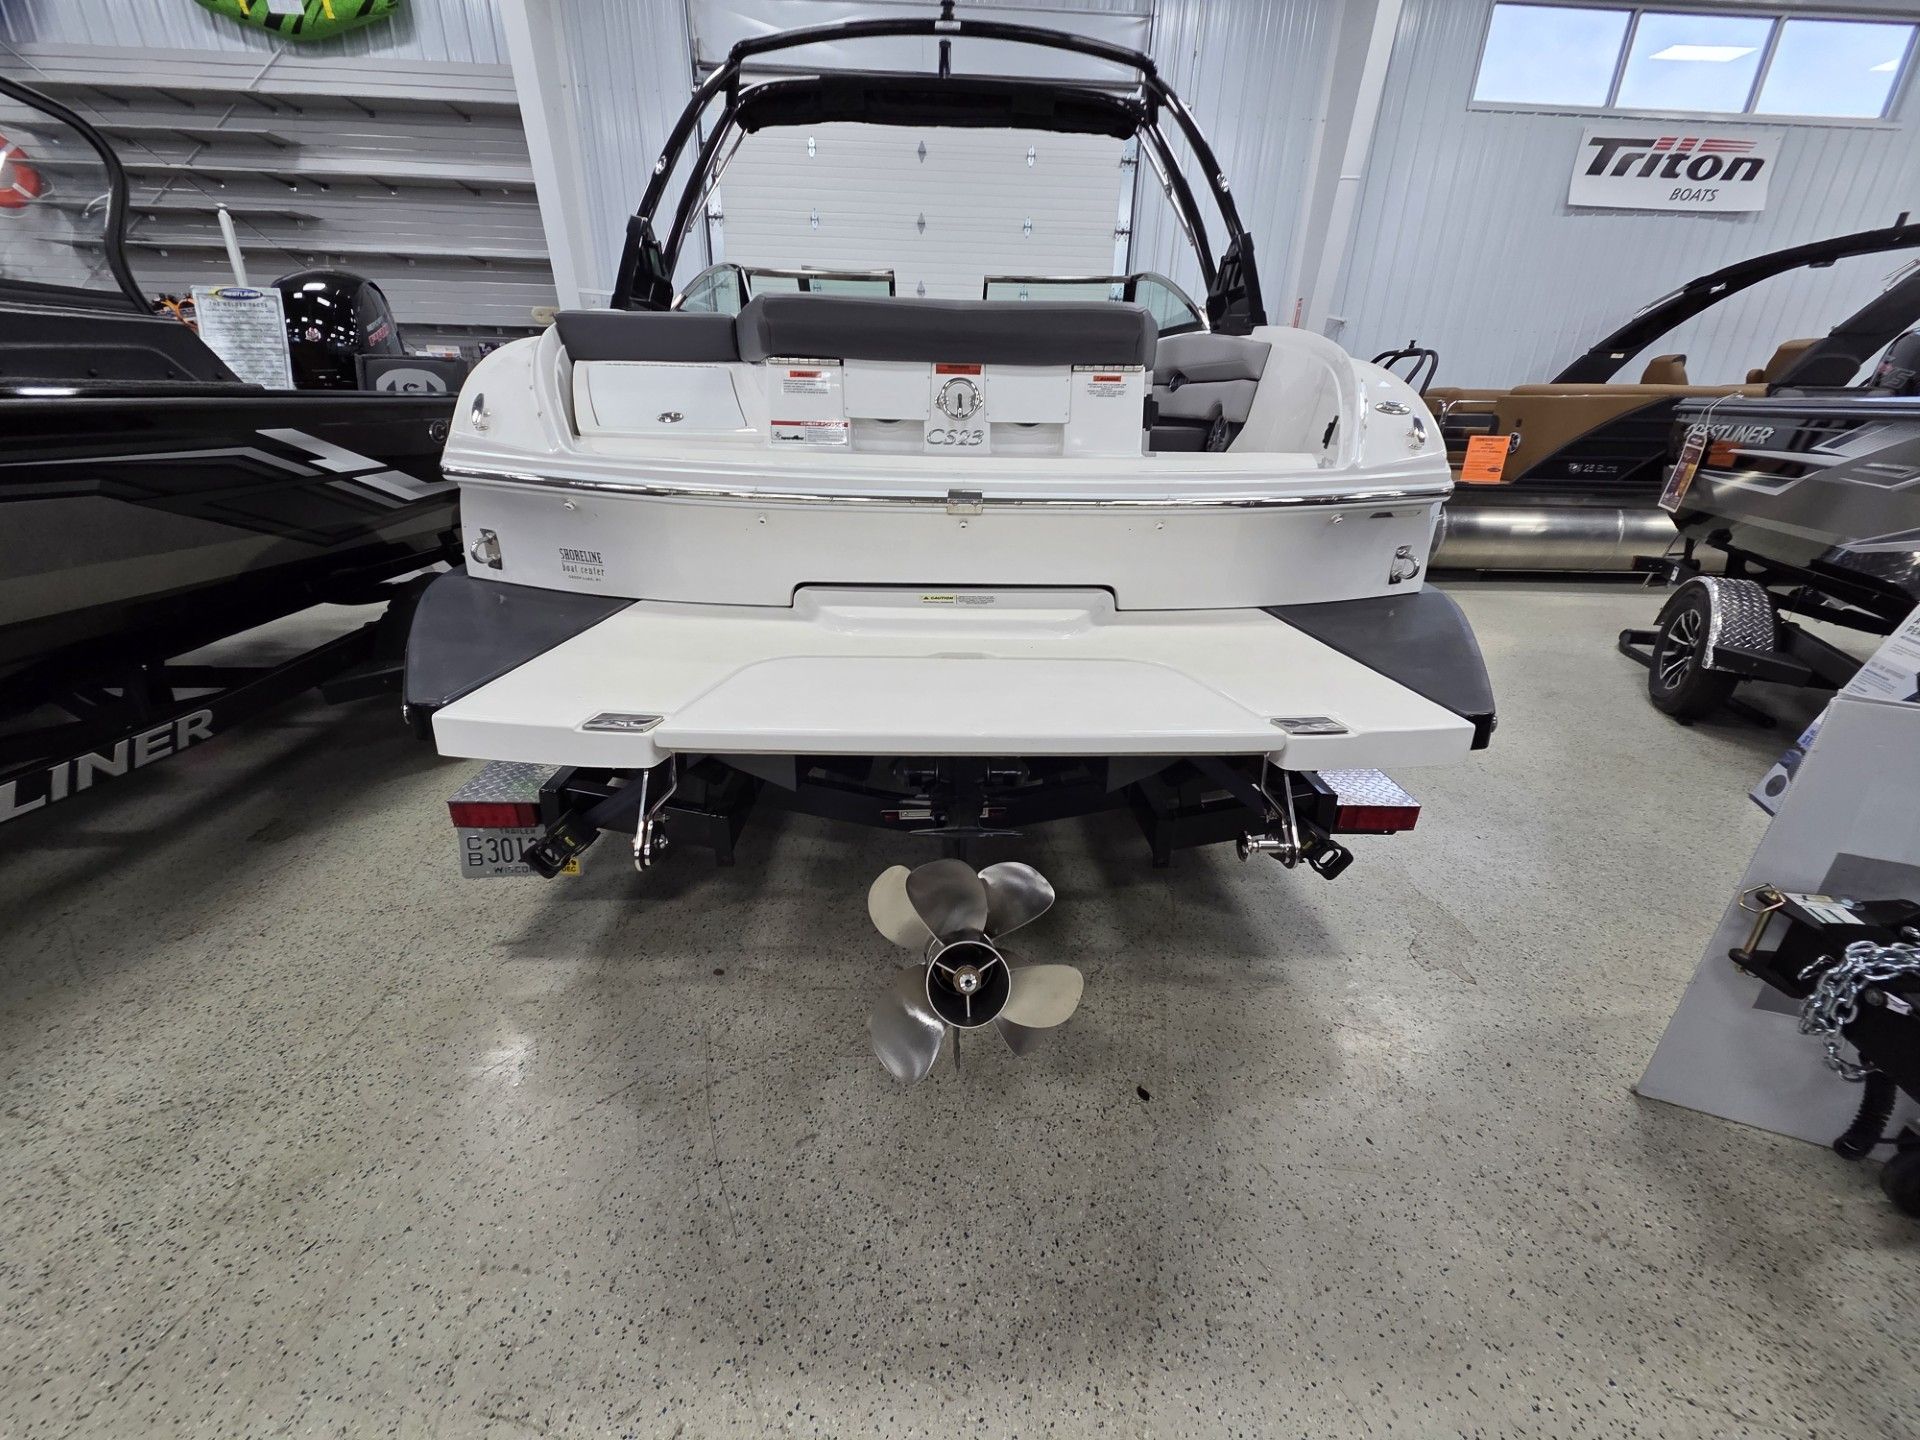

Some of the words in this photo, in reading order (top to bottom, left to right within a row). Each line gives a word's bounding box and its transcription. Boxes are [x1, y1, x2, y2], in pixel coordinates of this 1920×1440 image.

[1585, 137, 1766, 182] Triton
[1669, 188, 1720, 202] BOATS
[927, 428, 985, 446] CS23
[559, 548, 603, 564] SHORELINE
[562, 561, 578, 573] boat
[581, 566, 605, 576] center
[0, 709, 213, 822] LINER
[485, 837, 537, 864] 301
[494, 865, 533, 874] WISCO
